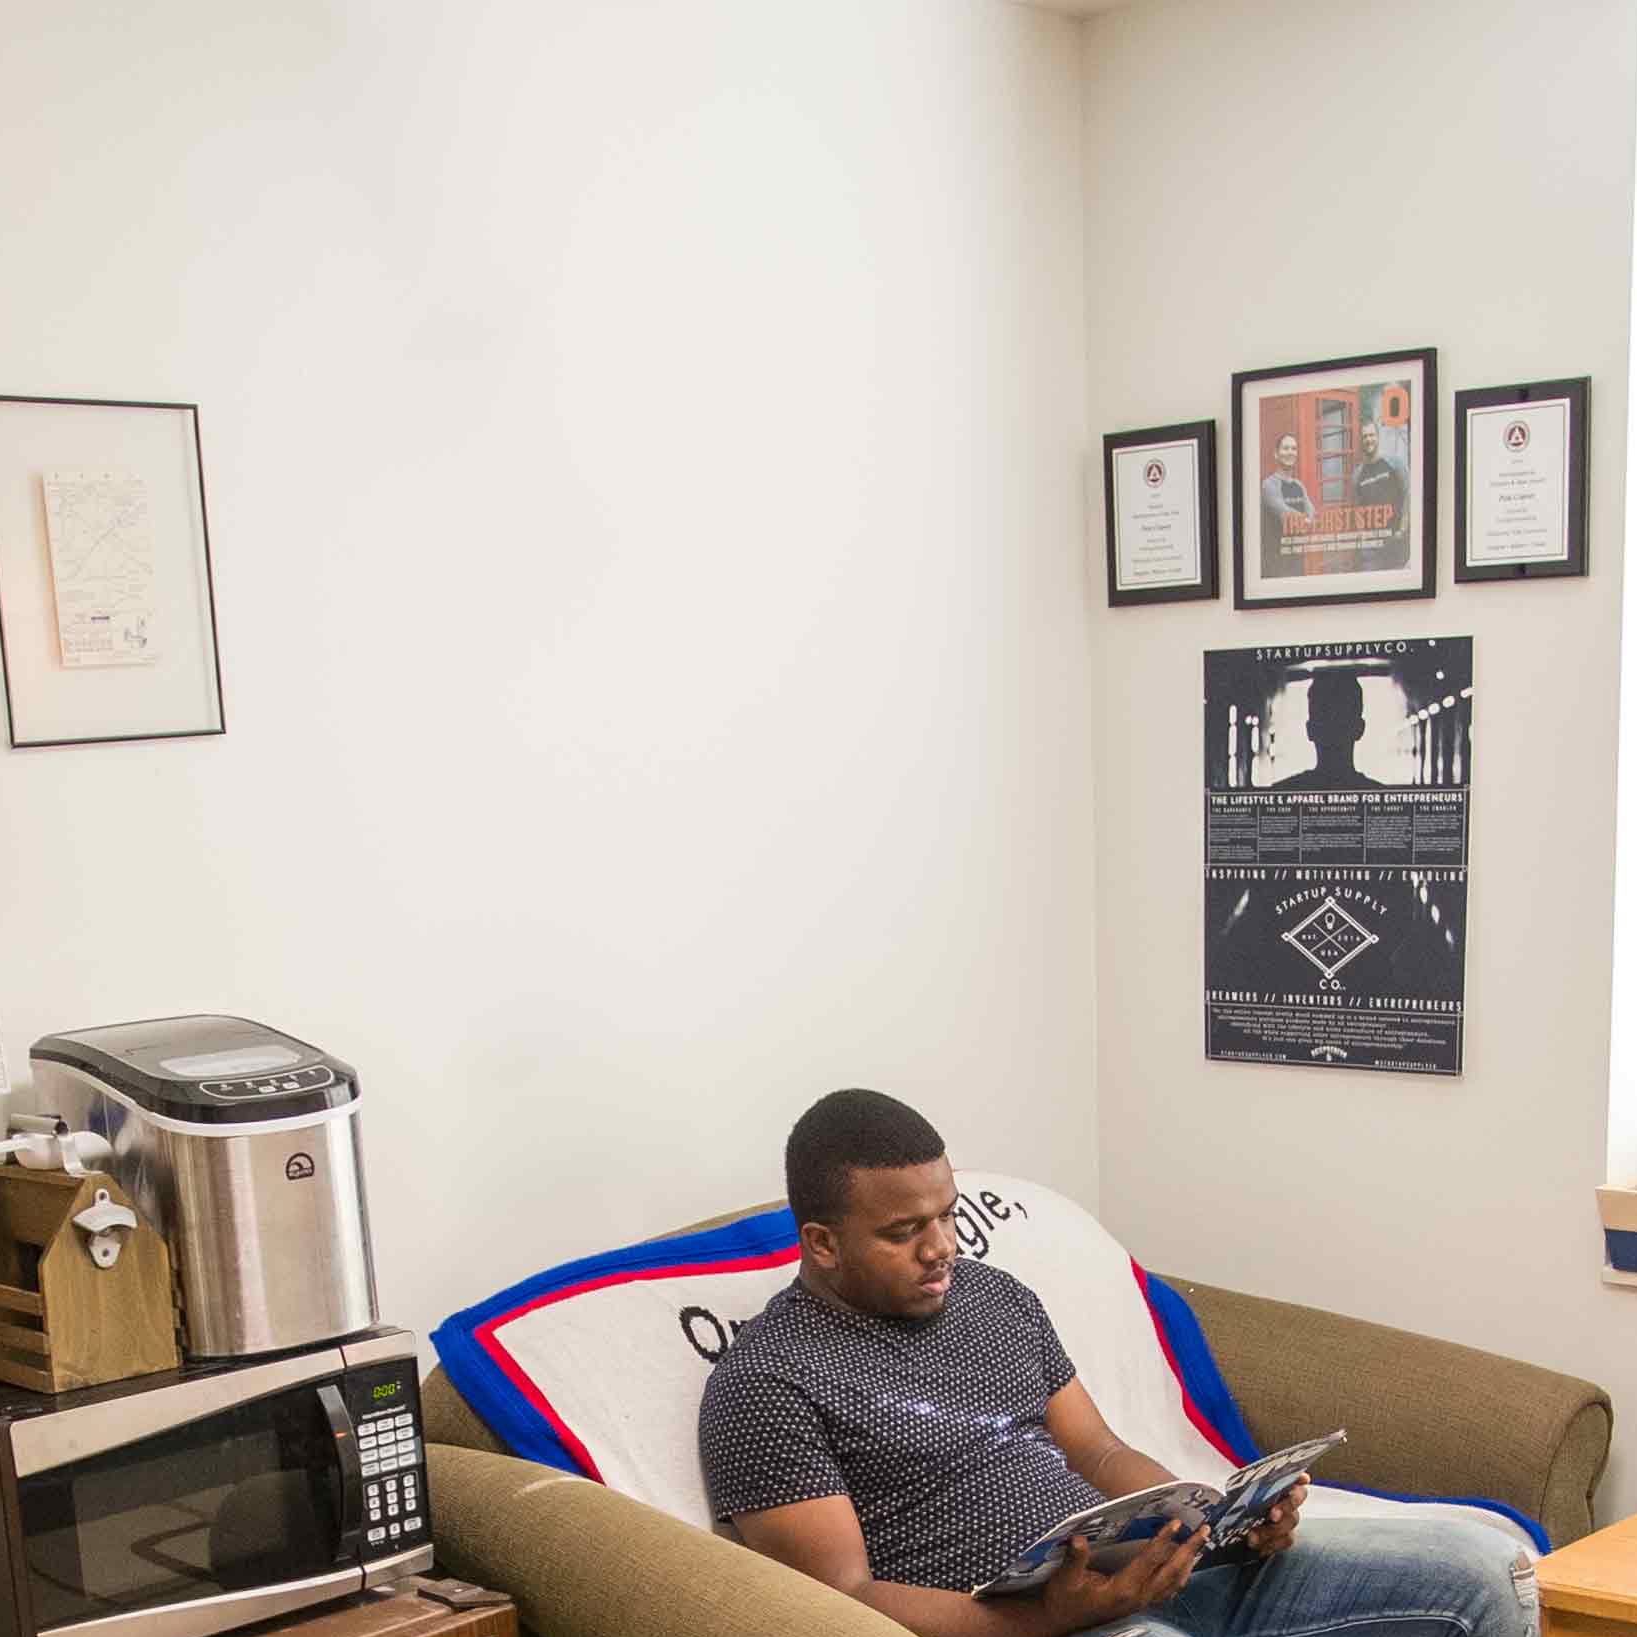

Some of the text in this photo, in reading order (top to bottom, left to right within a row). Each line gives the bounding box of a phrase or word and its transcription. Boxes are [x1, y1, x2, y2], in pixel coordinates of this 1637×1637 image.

[1354, 504, 1394, 529] STEP
[1211, 795, 1227, 805] THE
[1230, 795, 1274, 805] LIFESTYLE
[1286, 794, 1325, 804] APPAREL
[1328, 794, 1359, 803] BRAND
[1362, 793, 1381, 803] FOR
[1384, 792, 1463, 803] ENTREPRENEURS
[1295, 869, 1370, 881] MOTIVATING
[1275, 886, 1388, 915] STARTUP SUPPLY
[1282, 993, 1343, 1006] INVENTORS
[1369, 997, 1462, 1012] ENTREPRENEURS
